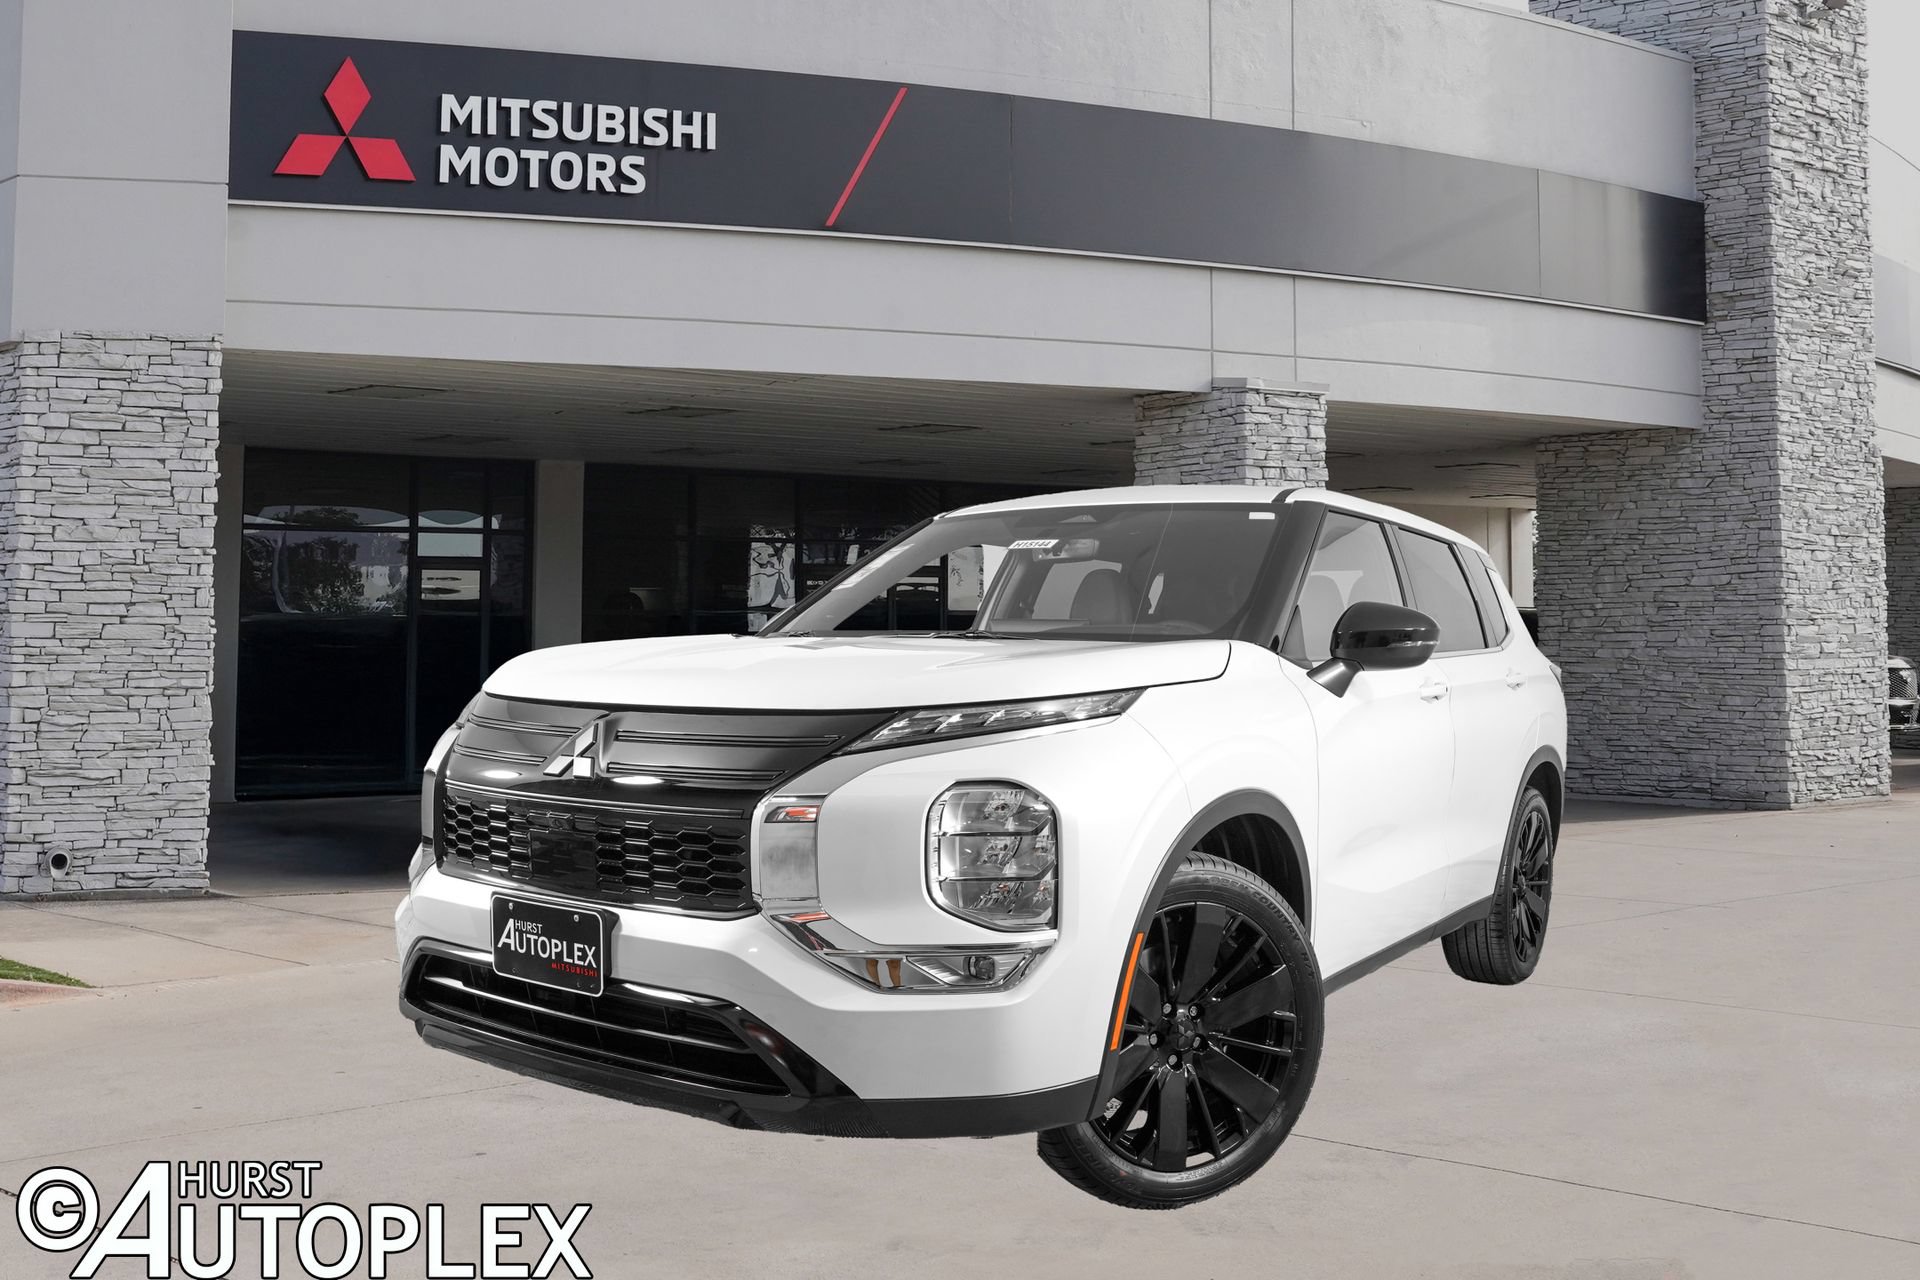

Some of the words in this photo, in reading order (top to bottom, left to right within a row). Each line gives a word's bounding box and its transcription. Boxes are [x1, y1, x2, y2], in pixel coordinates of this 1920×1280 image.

[439, 93, 717, 151] MITSUBISHI
[438, 144, 647, 194] MOTORS
[497, 918, 597, 968] AUTOPLEX
[515, 919, 543, 934] HURST
[551, 962, 598, 978] MITSUBISHI
